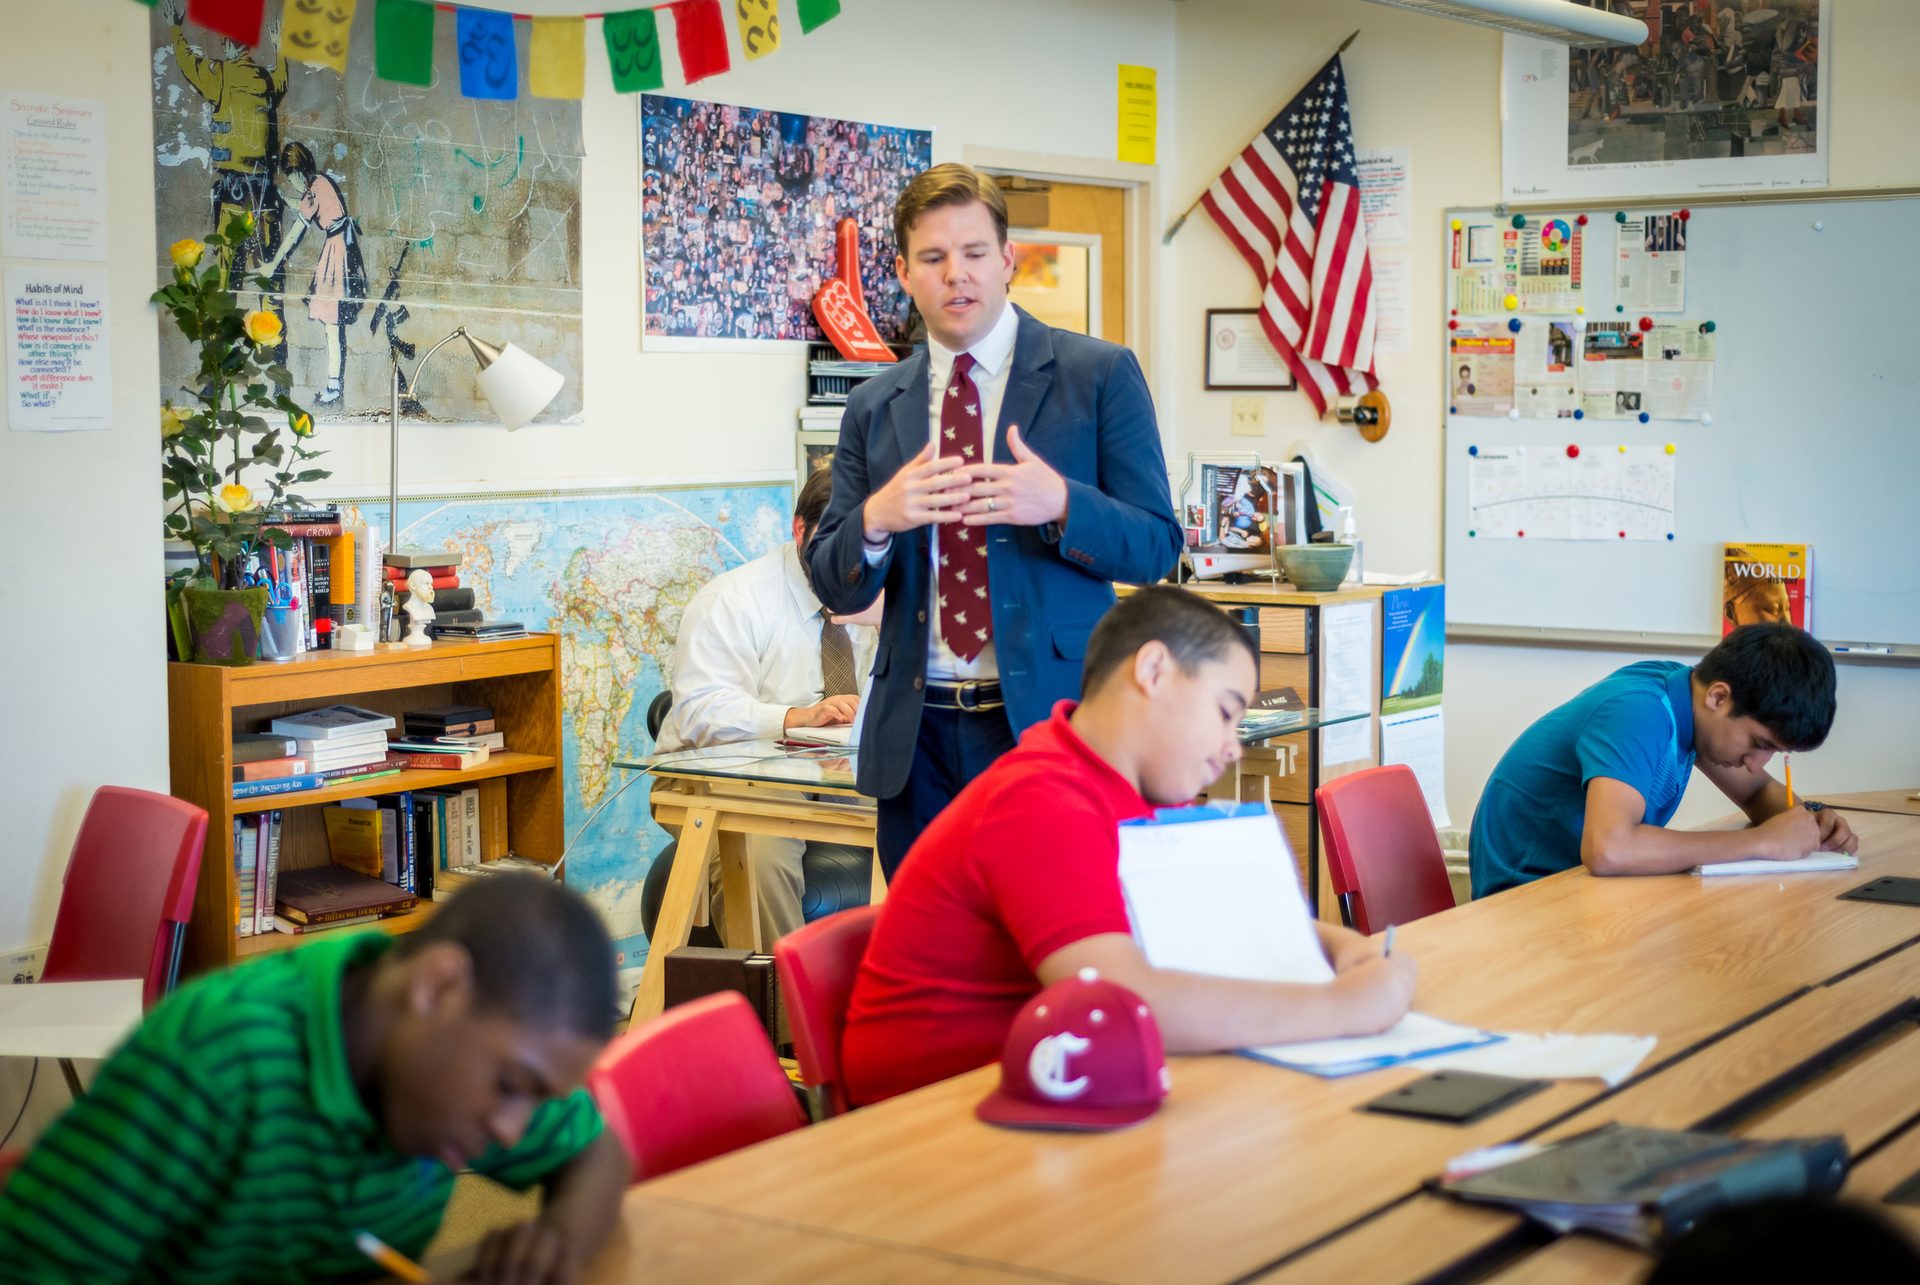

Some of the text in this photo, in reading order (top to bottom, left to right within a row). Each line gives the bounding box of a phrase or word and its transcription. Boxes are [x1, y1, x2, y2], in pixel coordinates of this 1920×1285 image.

[10, 99, 92, 117] Socratic Seminars
[26, 114, 76, 129] Ground Rules
[26, 284, 83, 294] Habits of Mind
[33, 400, 55, 408] what?
[306, 528, 332, 537] CROW
[1734, 563, 1801, 579] WORLD
[267, 836, 279, 877] Inklings
